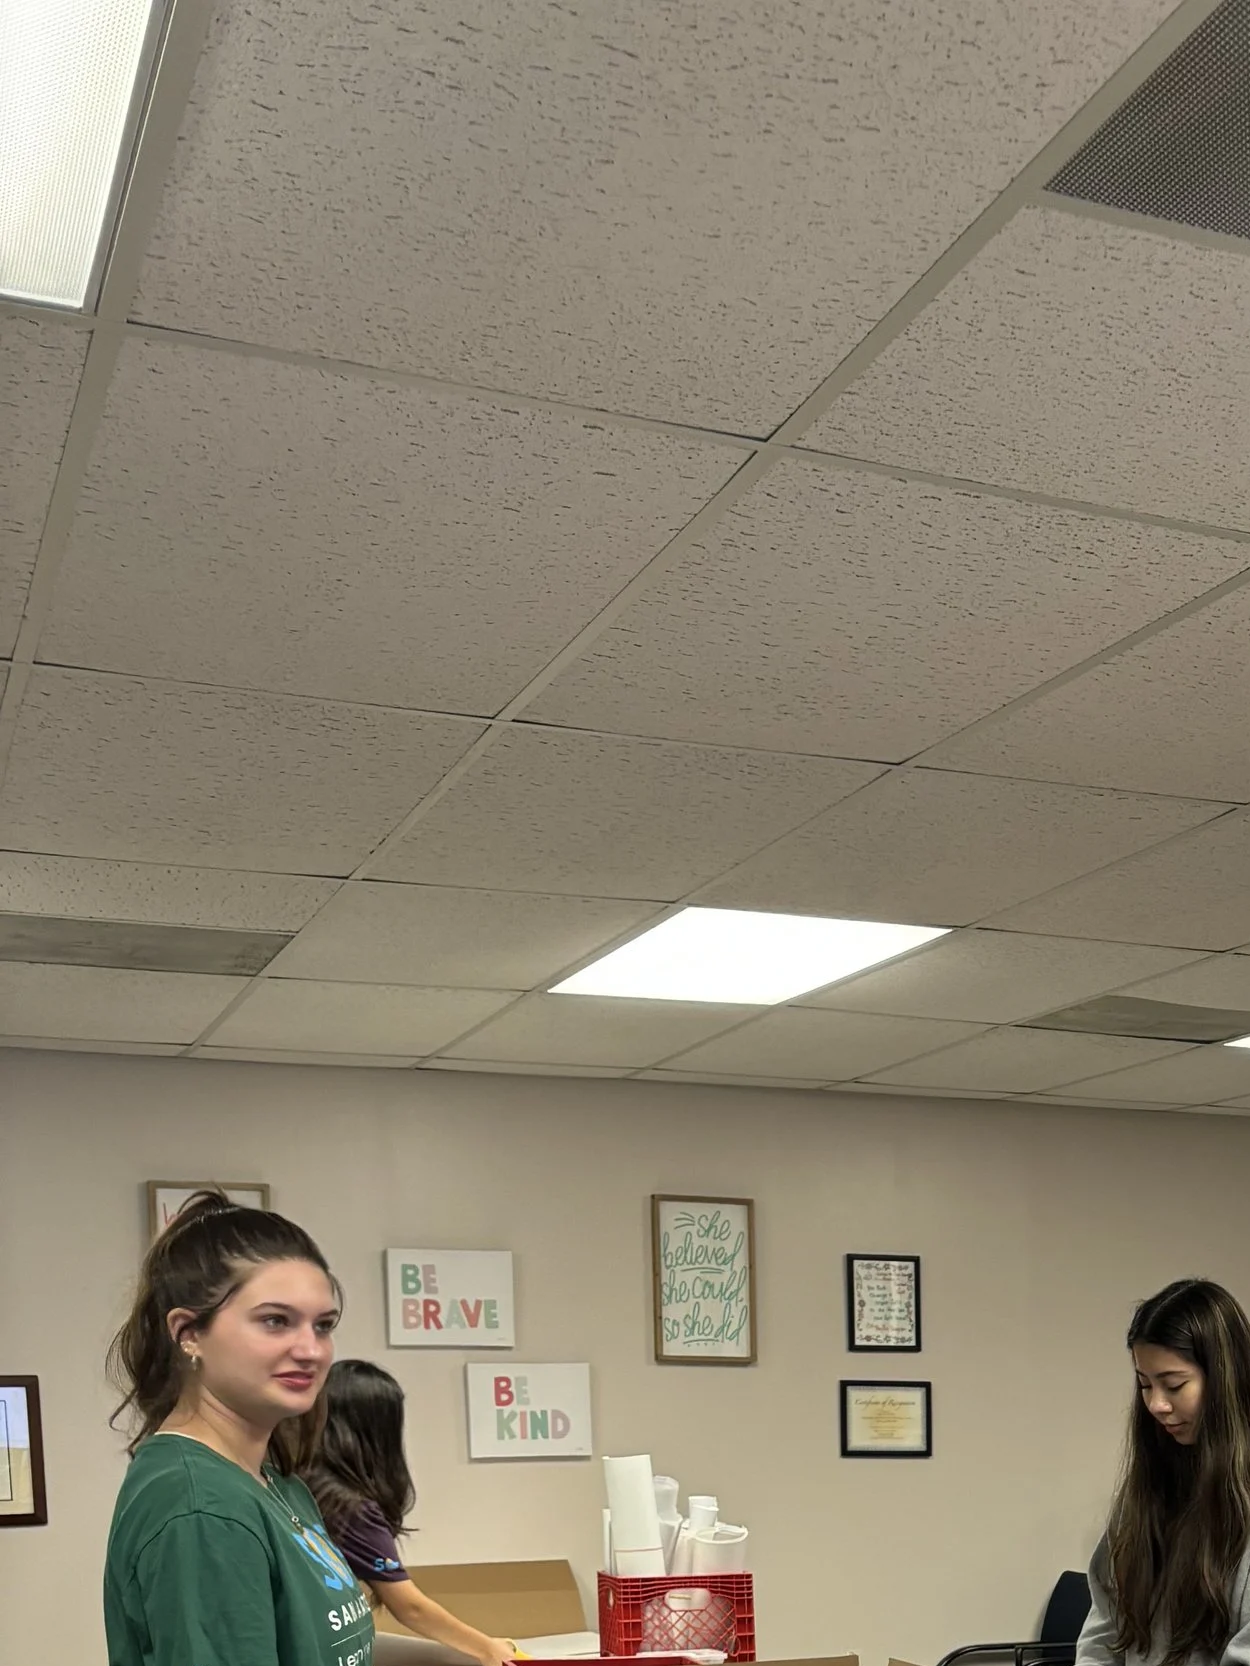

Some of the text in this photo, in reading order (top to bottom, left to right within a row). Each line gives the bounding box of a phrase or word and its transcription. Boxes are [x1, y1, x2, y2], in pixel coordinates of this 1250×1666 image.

[697, 1210, 731, 1241] she
[663, 1231, 745, 1271] believed
[401, 1263, 439, 1295] BE
[662, 1269, 690, 1306] she
[402, 1298, 499, 1330] BRAVE
[664, 1302, 748, 1346] so she did
[494, 1376, 530, 1407] BE
[496, 1409, 571, 1440] KIND
